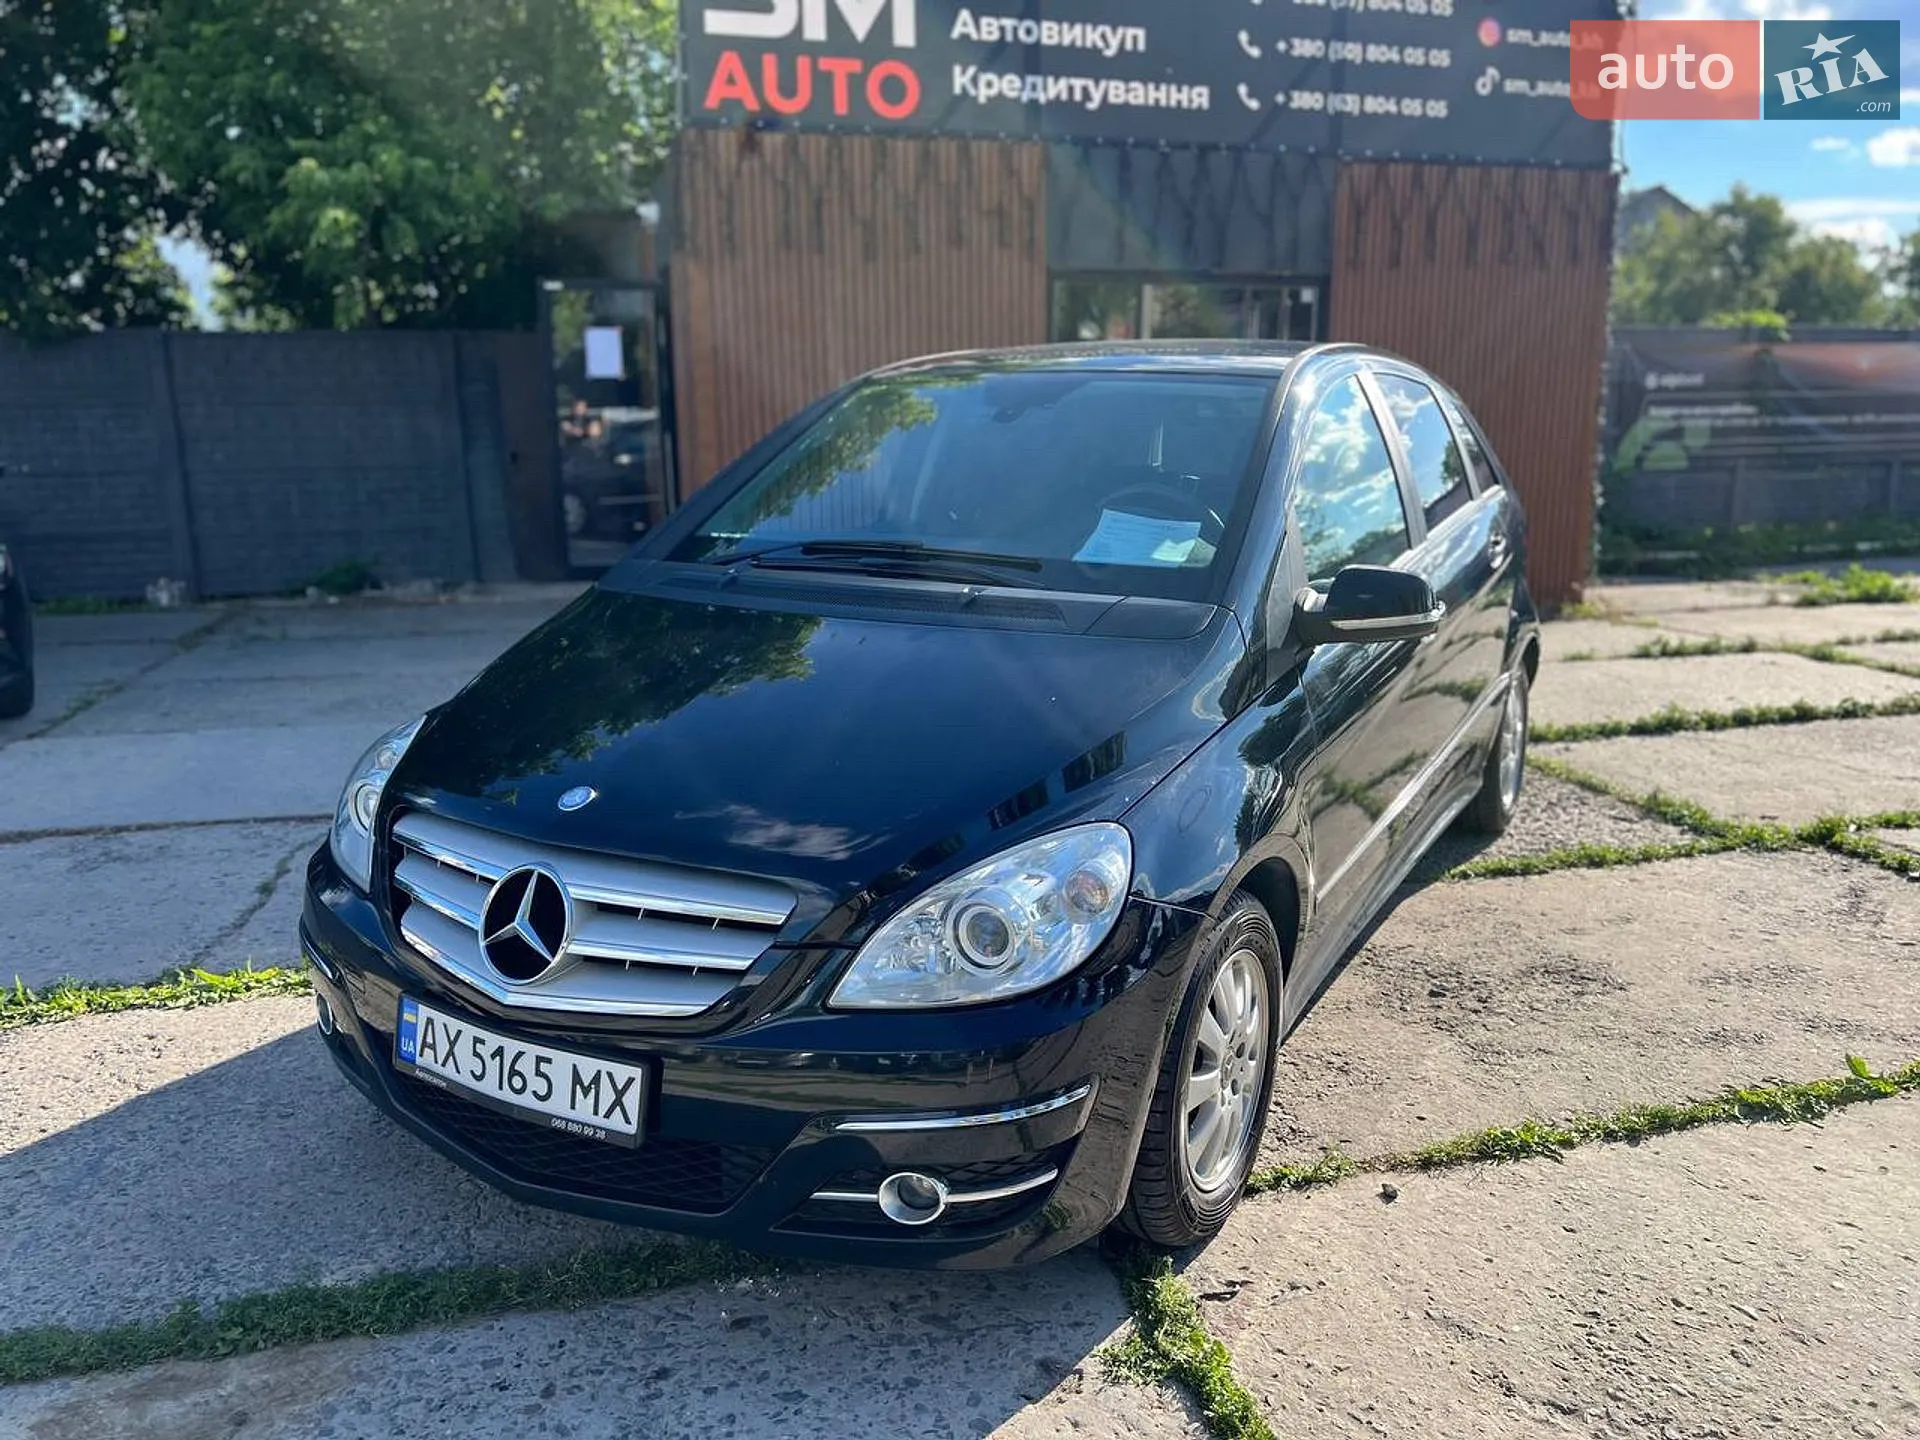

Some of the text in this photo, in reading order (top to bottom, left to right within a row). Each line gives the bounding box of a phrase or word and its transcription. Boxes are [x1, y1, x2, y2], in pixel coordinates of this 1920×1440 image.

[951, 8, 1147, 57] Автовикуп
[1365, 43, 1400, 62] 804
[1402, 46, 1426, 65] 05
[1428, 48, 1451, 67] 05
[704, 50, 920, 119] AUTO
[952, 64, 1210, 110] Кредитування
[1363, 93, 1398, 114] 804
[1400, 97, 1423, 116] 05
[1425, 98, 1448, 118] 05
[402, 1036, 415, 1054] UA
[419, 1017, 636, 1126] AX 5165 MX
